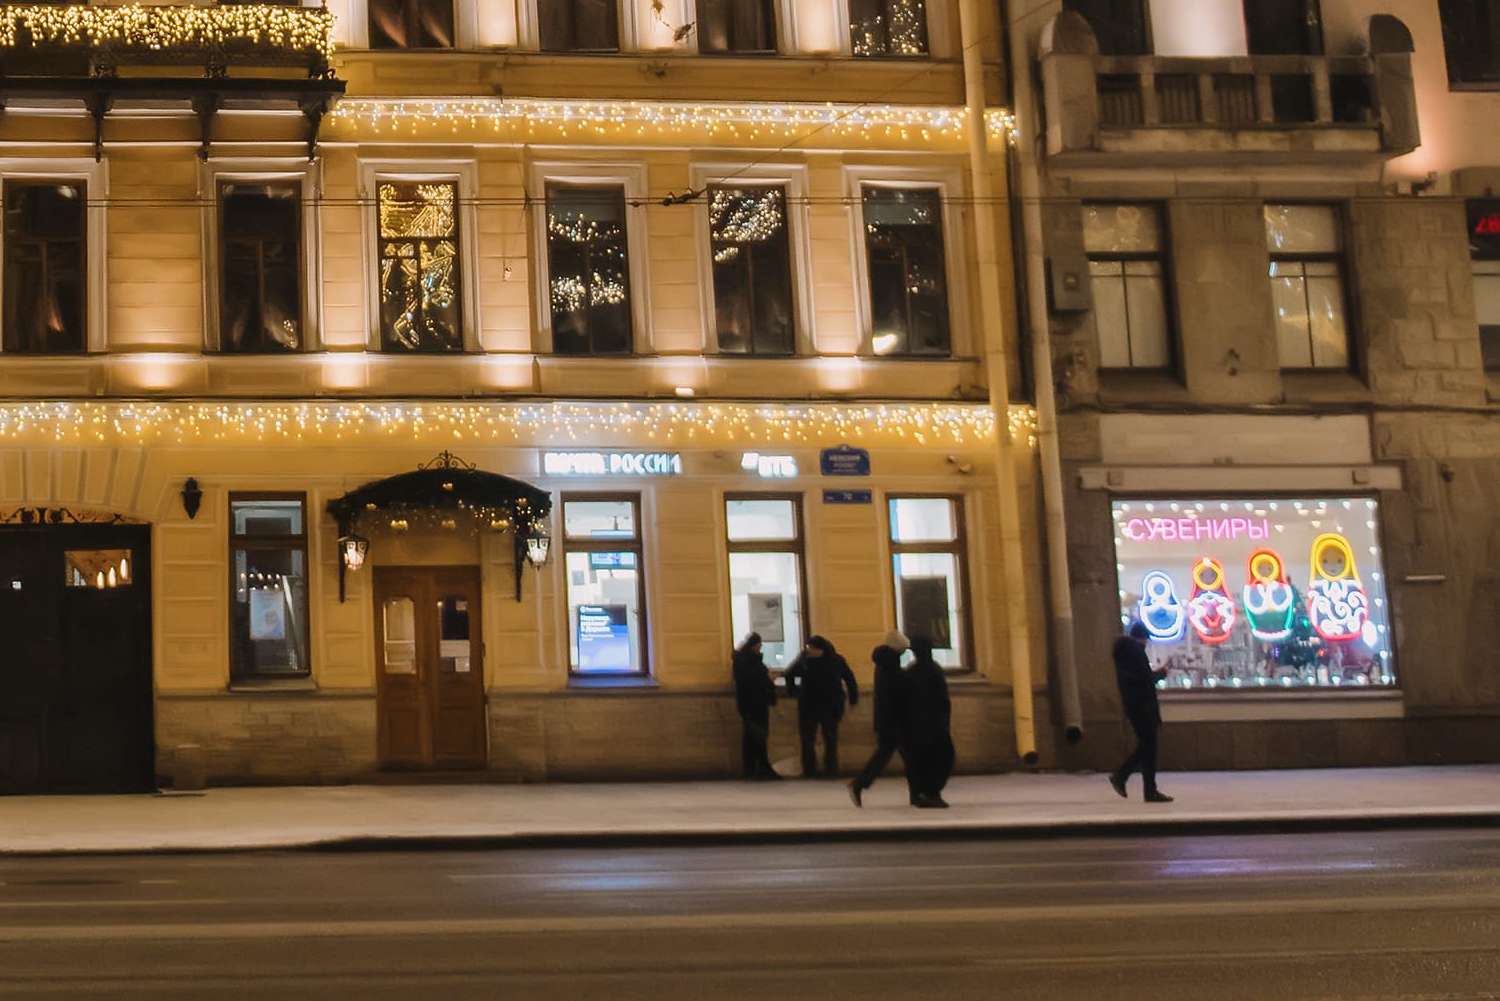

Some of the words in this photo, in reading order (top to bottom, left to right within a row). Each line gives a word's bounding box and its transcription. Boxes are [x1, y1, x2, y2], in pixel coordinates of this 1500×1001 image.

[610, 453, 682, 474] РОССИИ
[758, 456, 798, 478] ВТБ
[1127, 518, 1270, 541] СУВЕНИРЫ
